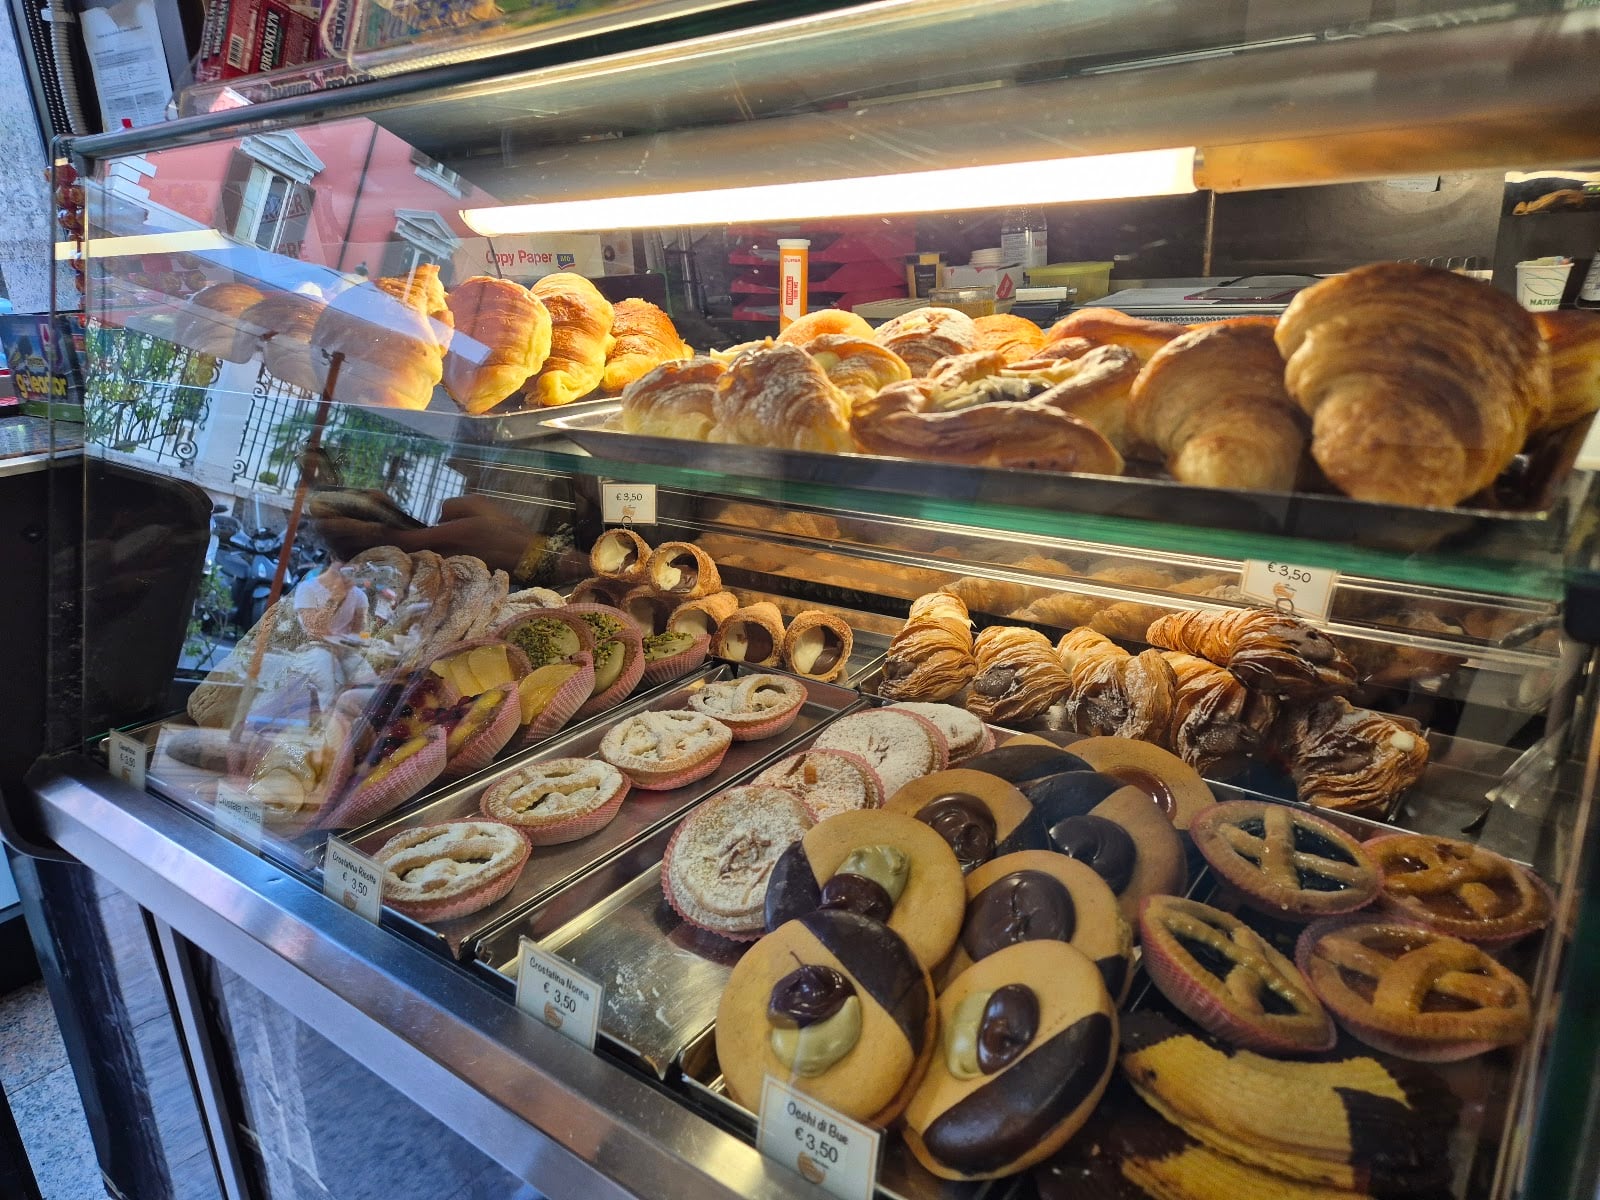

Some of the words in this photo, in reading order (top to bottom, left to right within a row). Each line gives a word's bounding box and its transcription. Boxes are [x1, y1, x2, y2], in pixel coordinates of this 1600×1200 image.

[260, 11, 280, 72] BROOKLYN
[485, 250, 515, 267] Copy
[518, 249, 553, 265] Paper
[623, 492, 643, 502] 3,50
[1267, 561, 1278, 573] €
[1279, 565, 1312, 583] 3,50
[332, 851, 358, 873] Crostatina
[358, 866, 377, 885] Ricotta
[342, 872, 348, 881] €
[351, 878, 368, 897] 3,50
[529, 956, 565, 987] Crostatina
[566, 978, 590, 1001] Nonna
[543, 982, 550, 993] €
[554, 989, 576, 1013] 3,50
[787, 1101, 817, 1128] Occhi
[817, 1119, 827, 1134] di
[828, 1124, 849, 1145] Bue
[795, 1127, 804, 1141] €
[805, 1133, 839, 1163] 3,50
